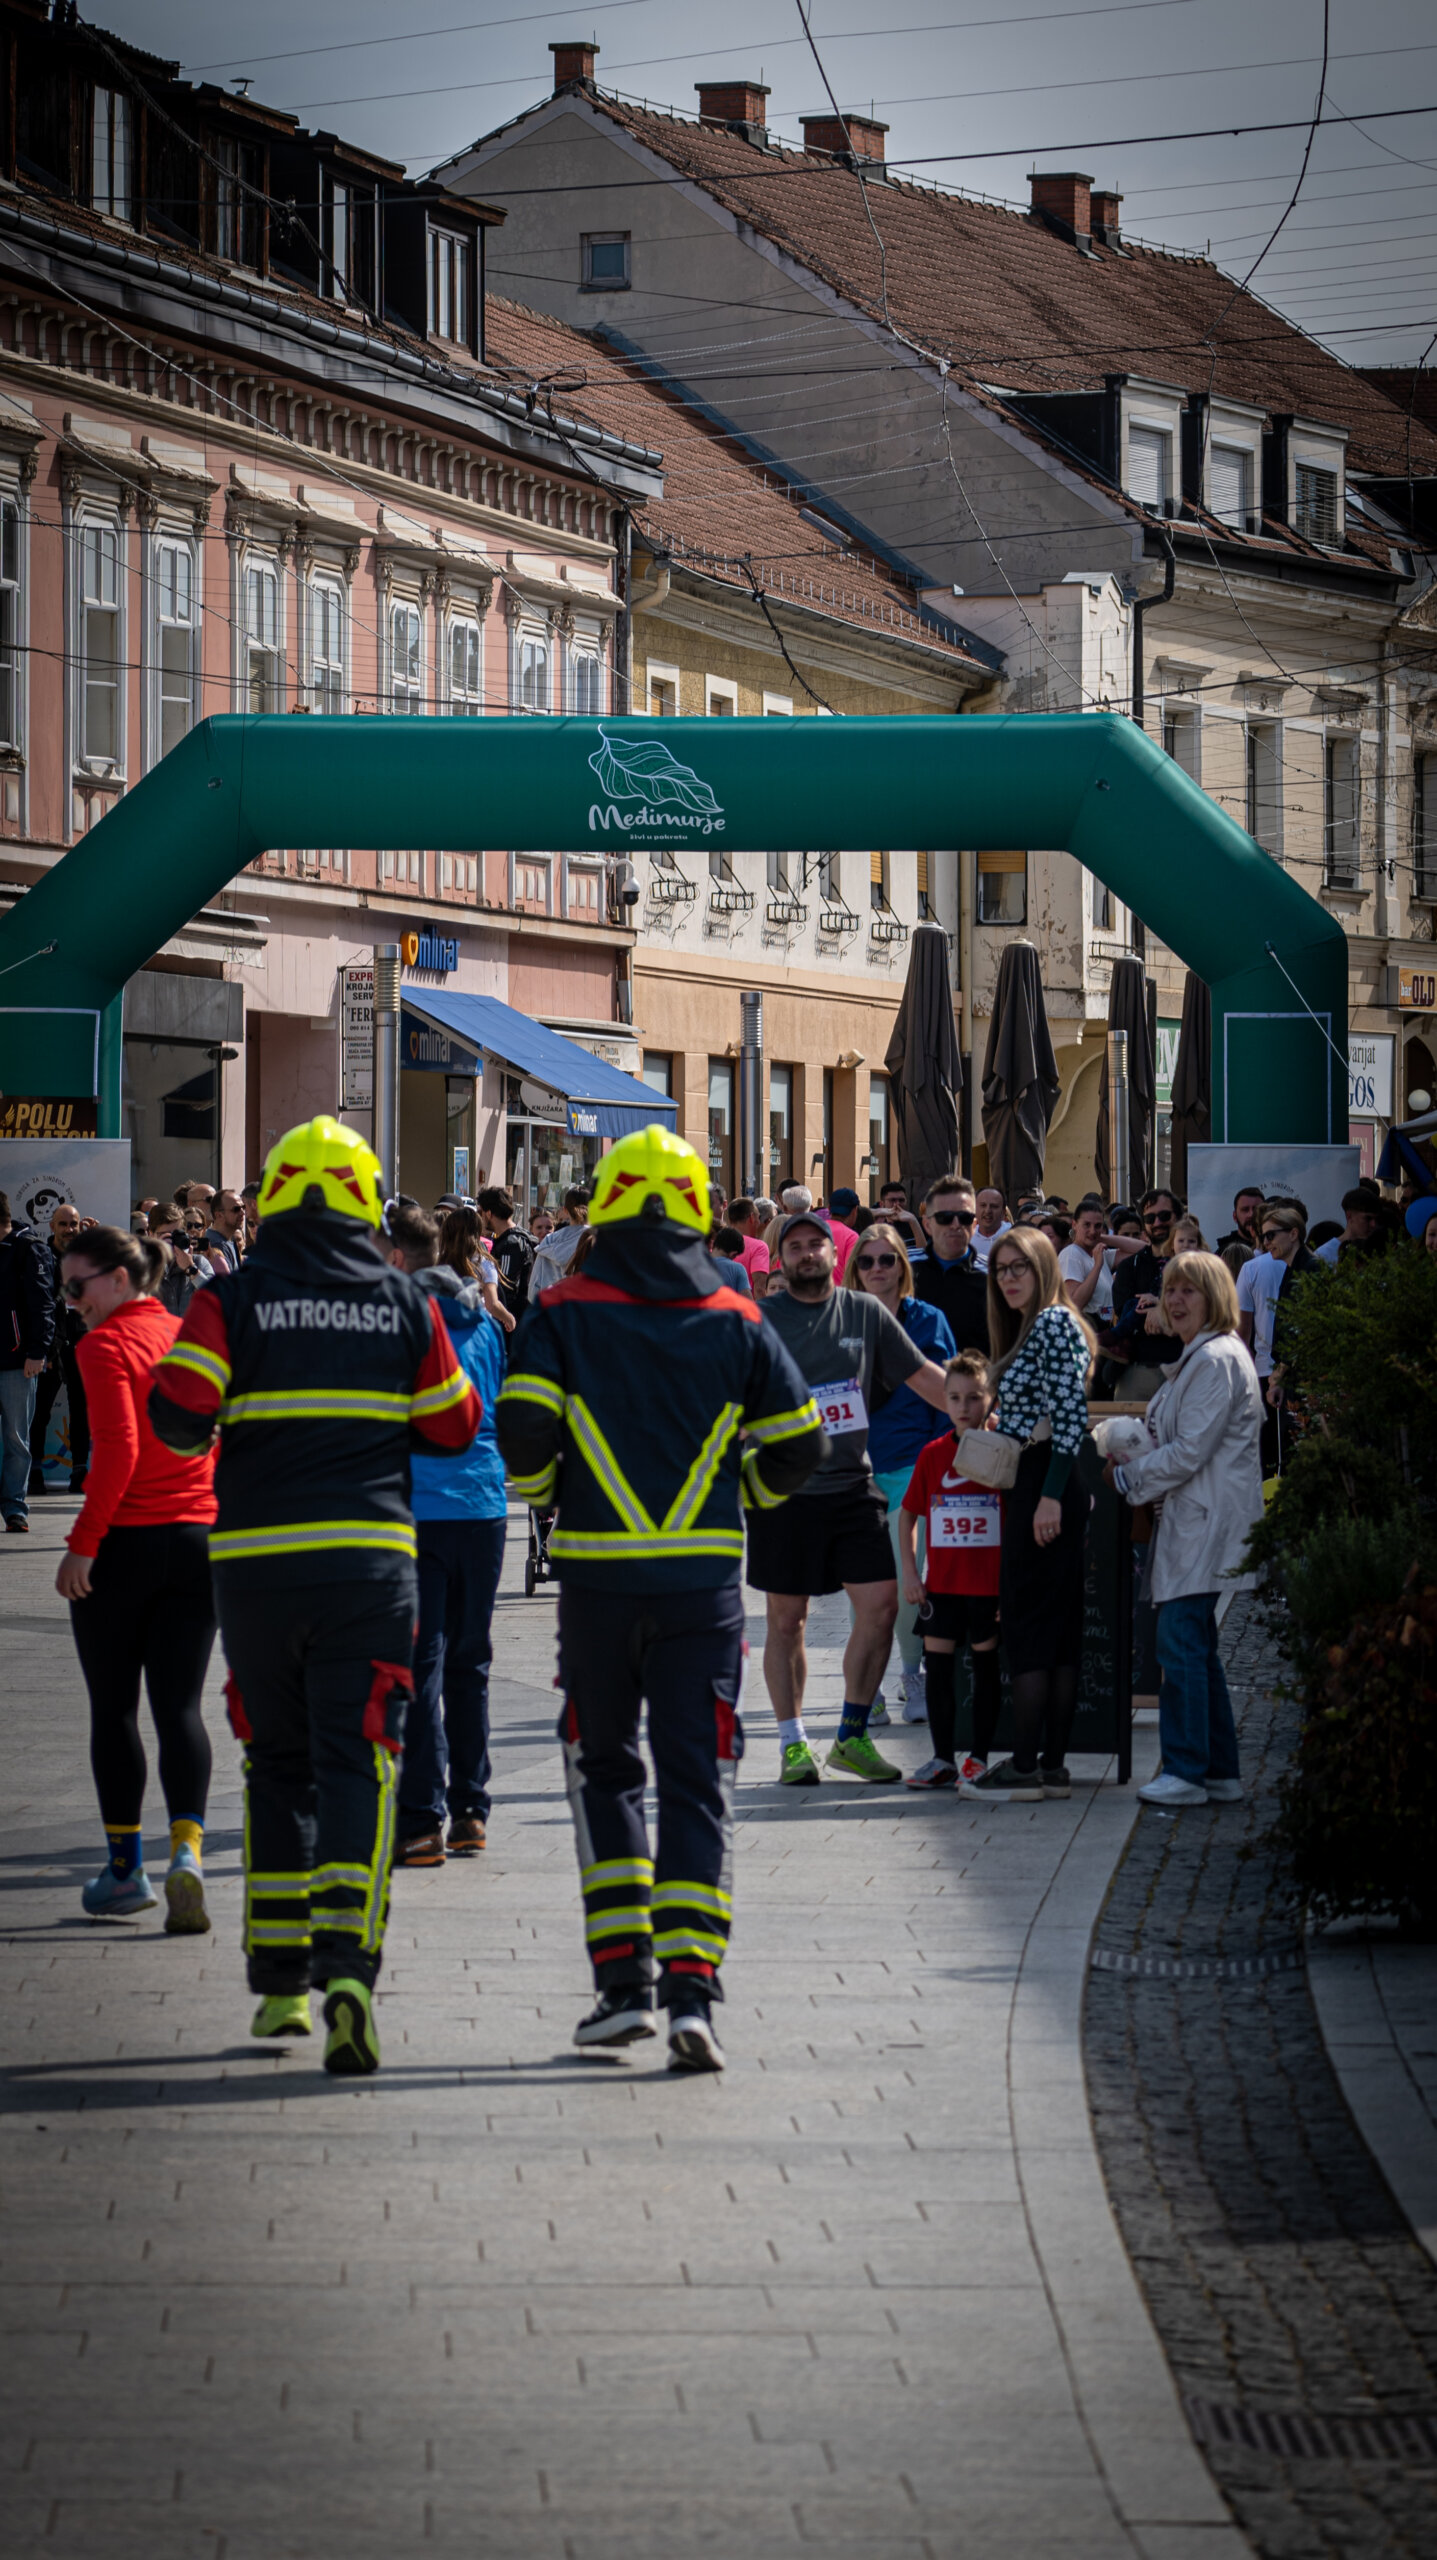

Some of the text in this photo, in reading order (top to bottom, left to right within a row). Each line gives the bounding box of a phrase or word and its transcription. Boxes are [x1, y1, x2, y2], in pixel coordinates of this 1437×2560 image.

[588, 804, 726, 834] Međimurje
[418, 925, 461, 972] mlinar
[1400, 975, 1435, 1006] bar OLD
[15, 1103, 73, 1130] POLU
[532, 1104, 563, 1113] KNJIŽARA
[254, 1299, 400, 1335] VATROGASCI
[942, 1517, 988, 1535] 392
